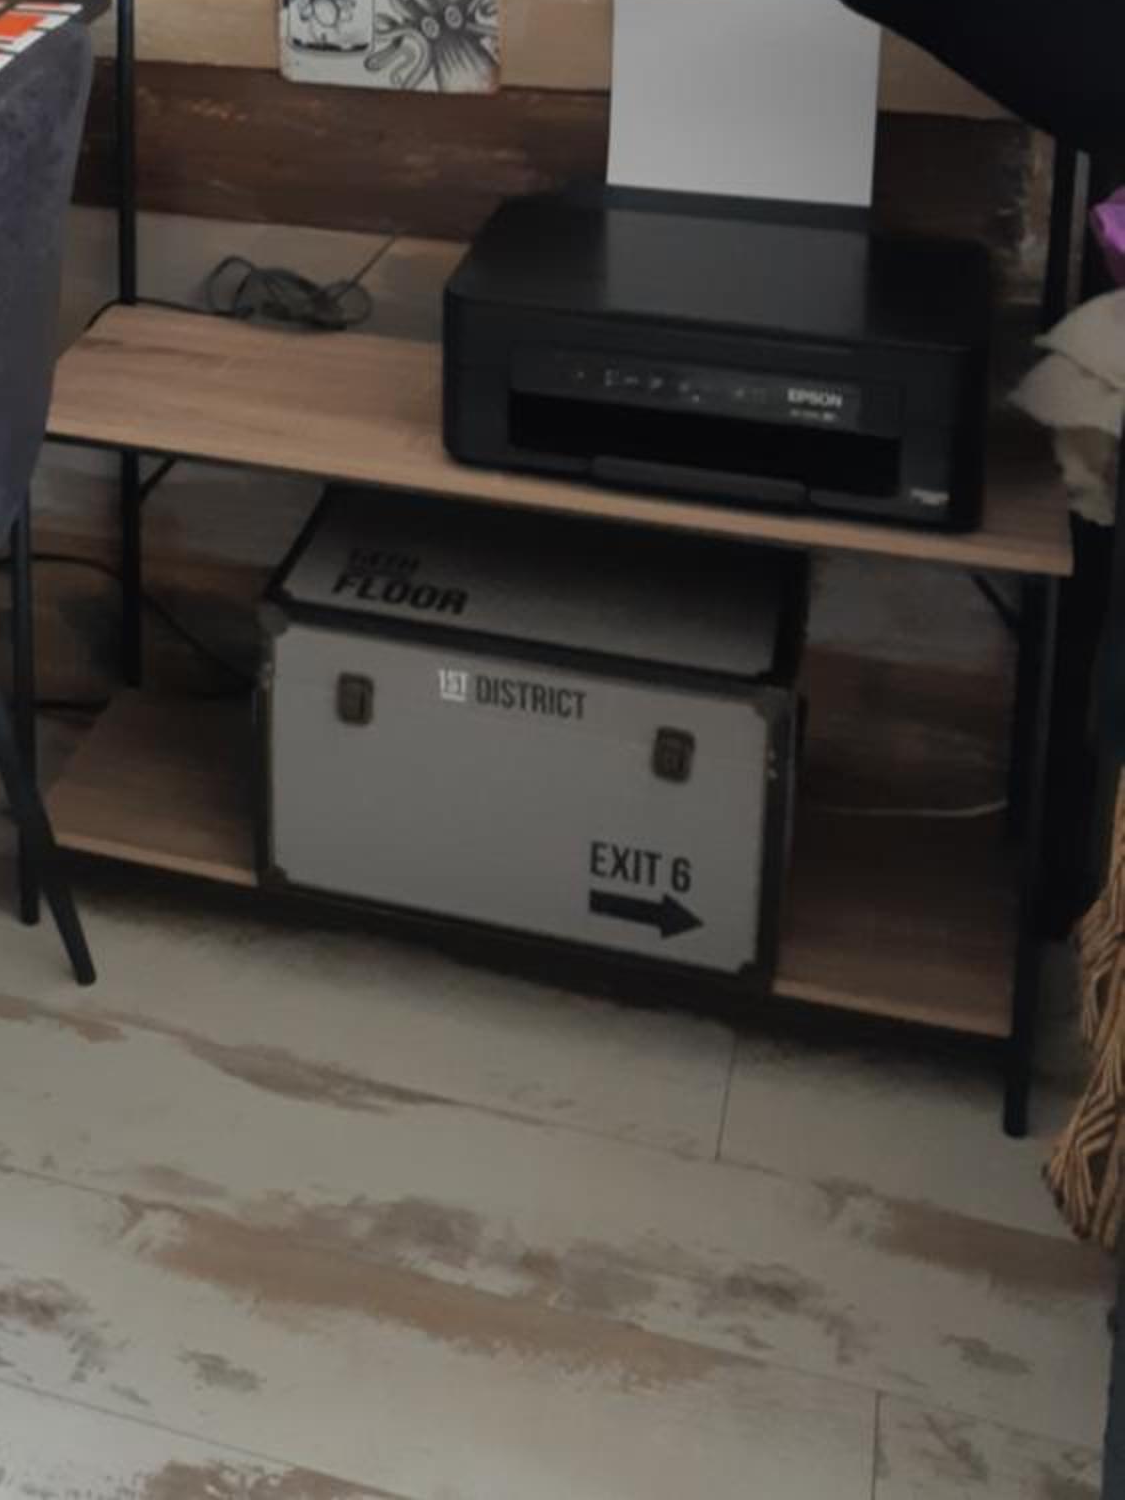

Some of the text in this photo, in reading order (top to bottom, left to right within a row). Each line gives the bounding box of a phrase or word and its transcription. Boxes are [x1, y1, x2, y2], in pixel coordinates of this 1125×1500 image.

[787, 388, 843, 409] EPSON
[332, 571, 469, 616] FLOOR
[475, 675, 587, 720] DISTRICT
[590, 840, 692, 894] EXIT 6
